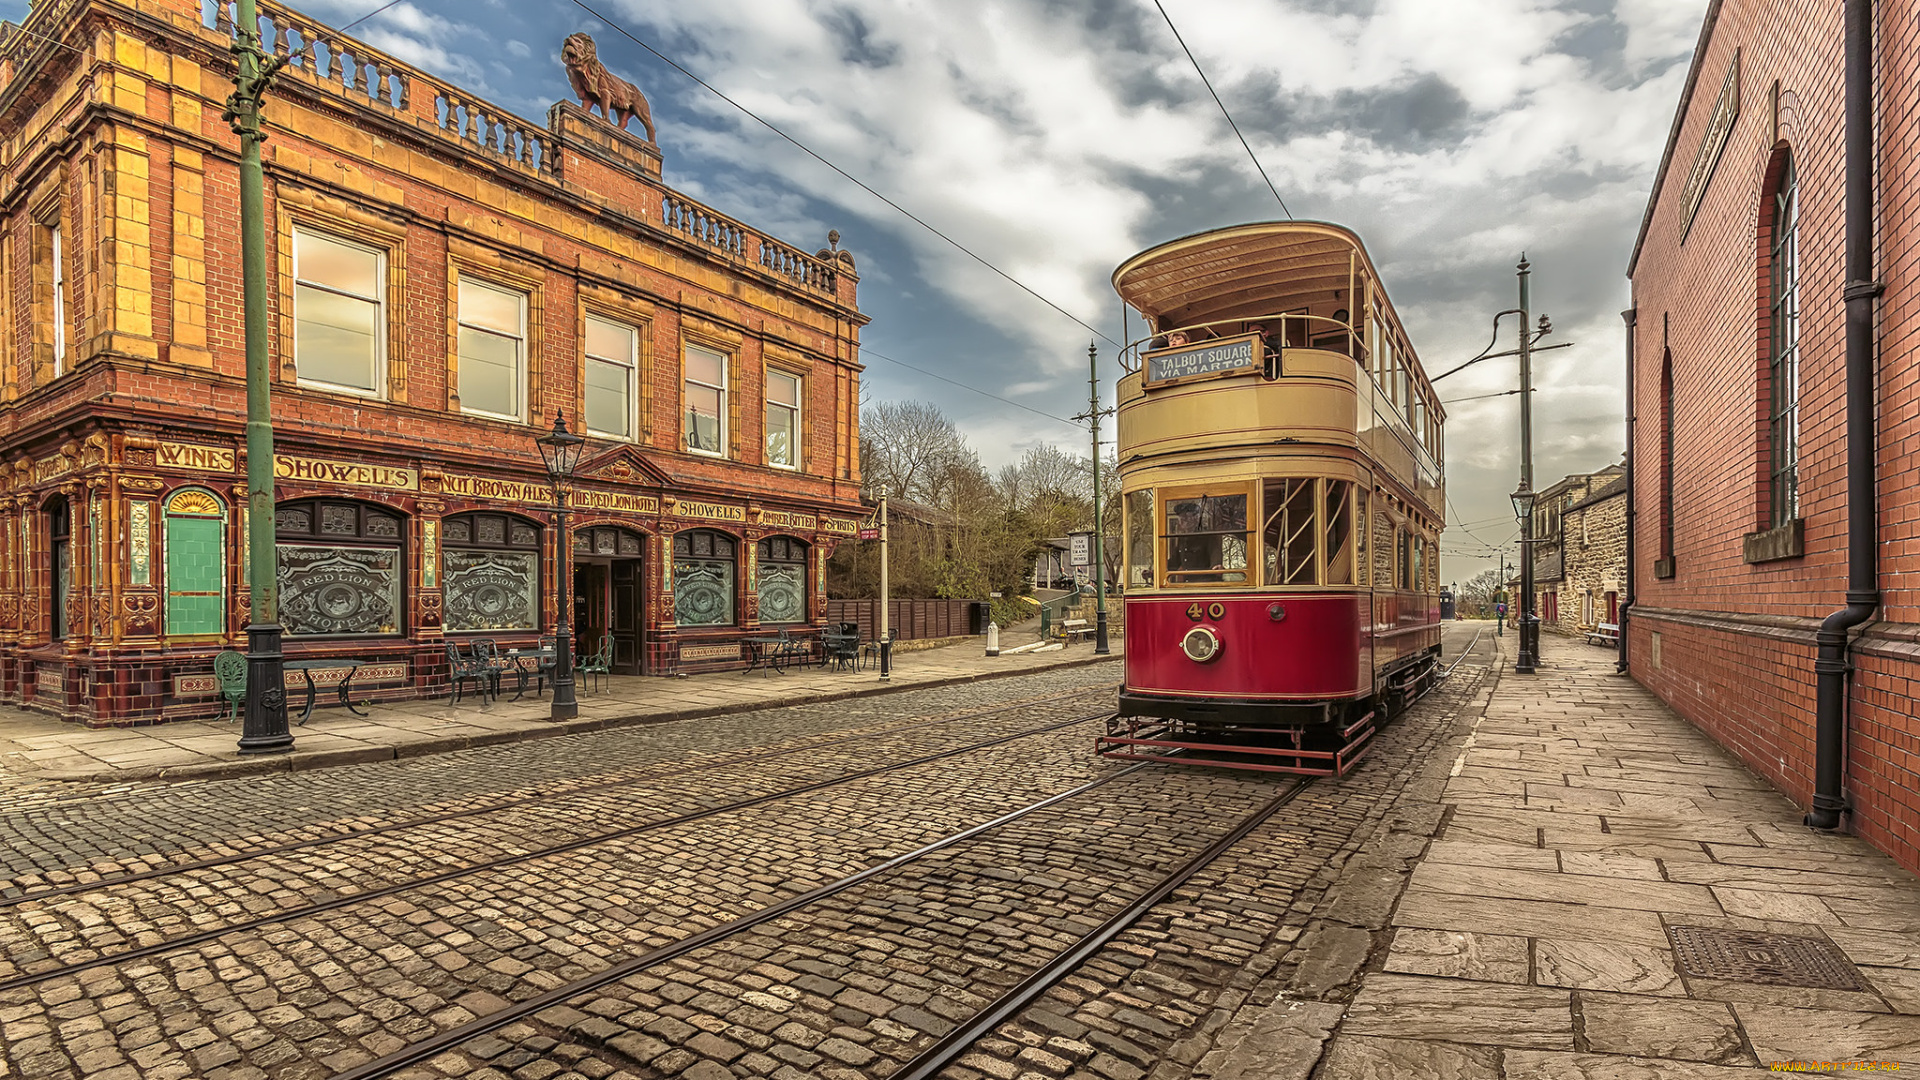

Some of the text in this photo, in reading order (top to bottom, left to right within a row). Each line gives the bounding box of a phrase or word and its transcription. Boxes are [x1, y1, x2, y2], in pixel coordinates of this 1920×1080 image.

[1160, 357, 1252, 378] VIA MARTON
[1161, 345, 1252, 371] TALBOT SQUARE
[157, 442, 235, 470] WINES
[276, 455, 408, 487] SHOWELL'S
[441, 475, 553, 502] NUT BROWN ALES
[826, 517, 855, 532] SPIRITS
[302, 574, 372, 587] RED LION
[462, 577, 516, 588] RED LION
[466, 612, 514, 625] HOTEL
[1186, 602, 1226, 621] 40
[308, 614, 369, 629] HOTEL
